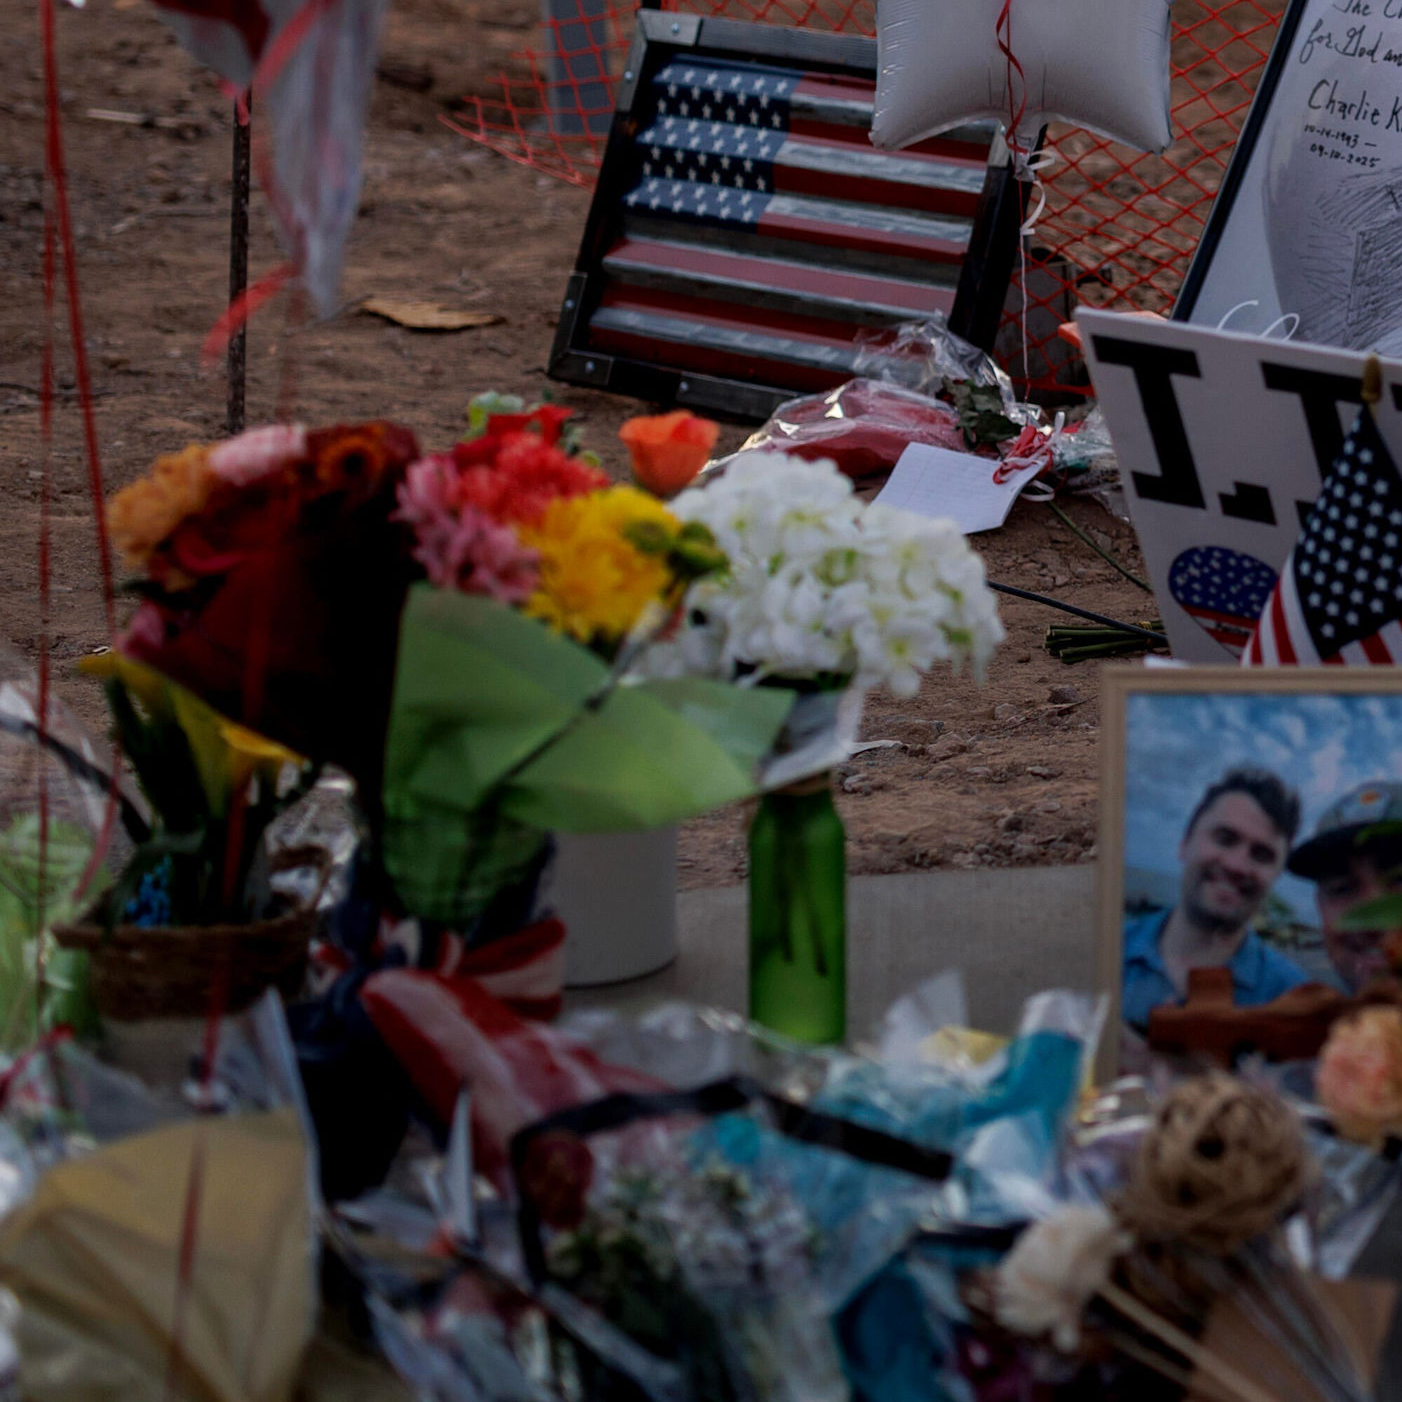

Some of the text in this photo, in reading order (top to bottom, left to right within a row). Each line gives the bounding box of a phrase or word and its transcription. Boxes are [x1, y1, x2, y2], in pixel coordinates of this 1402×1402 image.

[1300, 18, 1333, 64] for
[1335, 25, 1383, 63] God
[1308, 79, 1380, 126] Charlie
